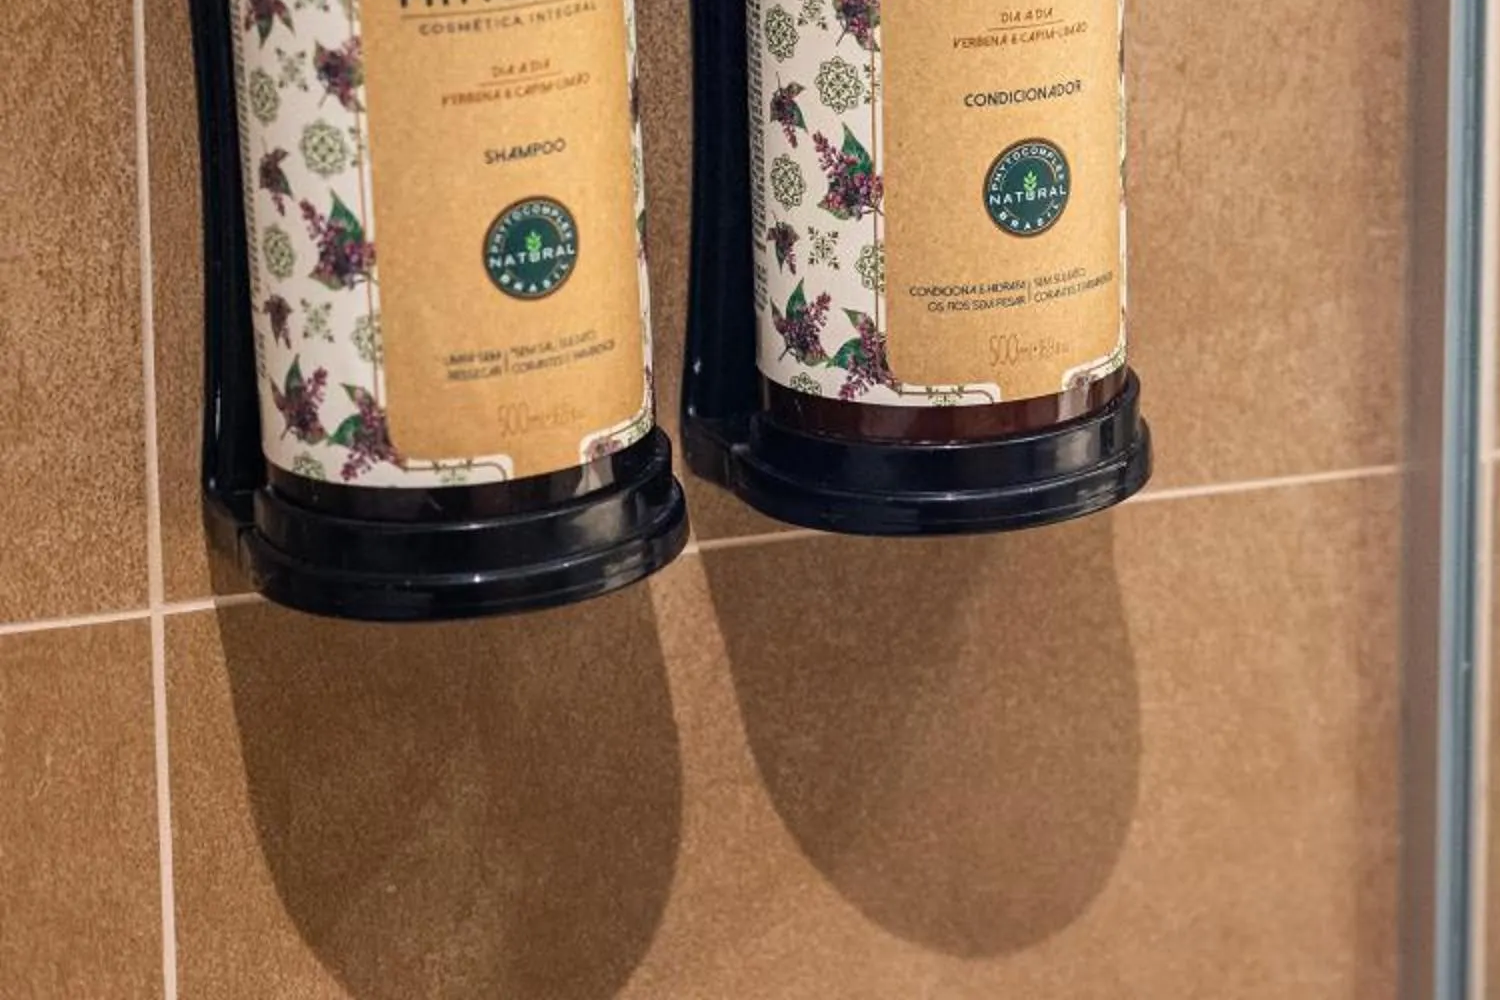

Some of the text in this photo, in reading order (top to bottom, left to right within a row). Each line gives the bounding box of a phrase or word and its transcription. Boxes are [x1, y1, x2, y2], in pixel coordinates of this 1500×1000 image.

[418, 14, 524, 36] COSMÉTICA
[963, 79, 1081, 108] CONDICIONADOR
[483, 137, 567, 165] SHAMPOO
[989, 184, 1067, 206] NATURAL
[488, 244, 575, 268] NATURAL
